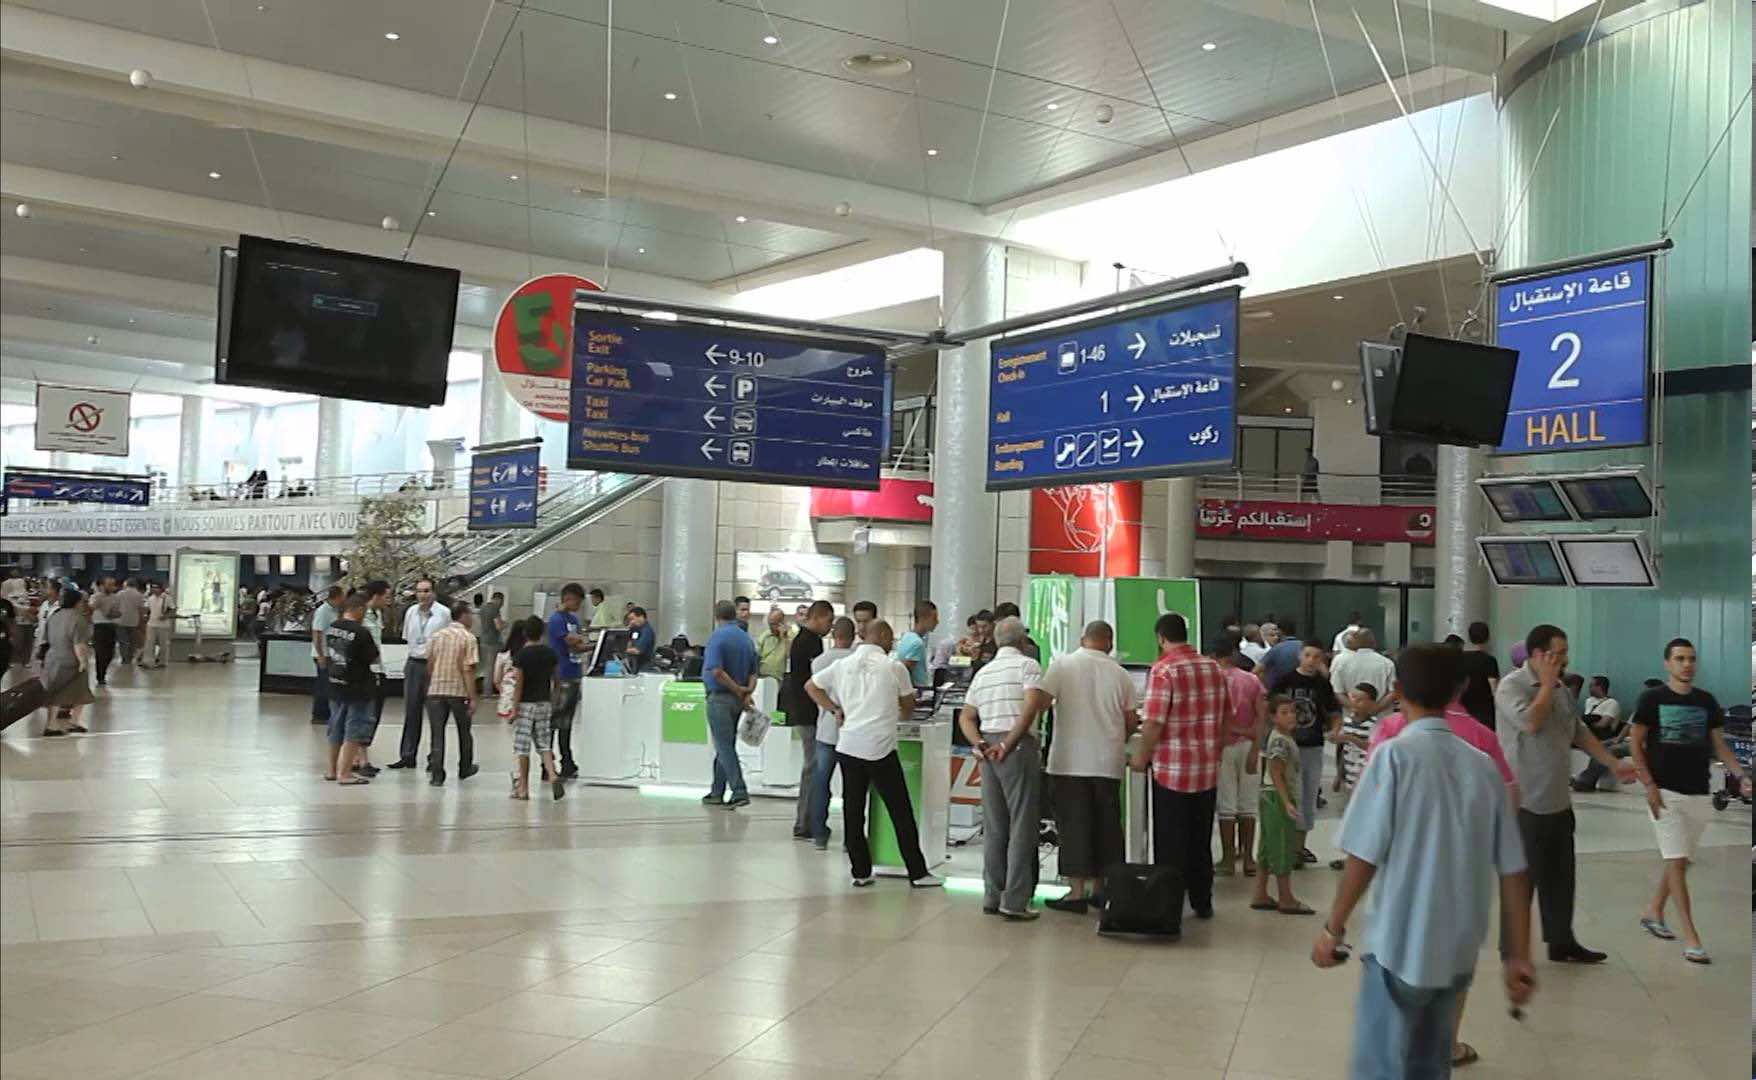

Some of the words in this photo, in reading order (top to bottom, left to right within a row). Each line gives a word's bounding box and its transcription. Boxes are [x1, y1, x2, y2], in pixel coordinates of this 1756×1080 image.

[1587, 270, 1632, 294] قاعة
[587, 330, 623, 344] Sortie
[588, 342, 610, 354] Exit
[728, 348, 764, 368] 9-10
[586, 362, 628, 378] Parking
[1547, 331, 1582, 389] 2
[585, 395, 609, 407] Taxi
[1100, 389, 1109, 413] 1
[585, 407, 609, 419] Taxi
[1188, 424, 1220, 446] ركوب
[1526, 410, 1606, 447] HALL
[174, 516, 200, 532] NOUS
[202, 515, 246, 531] SOMMES
[248, 514, 296, 531] PARTOUT
[300, 512, 327, 530] AVEC
